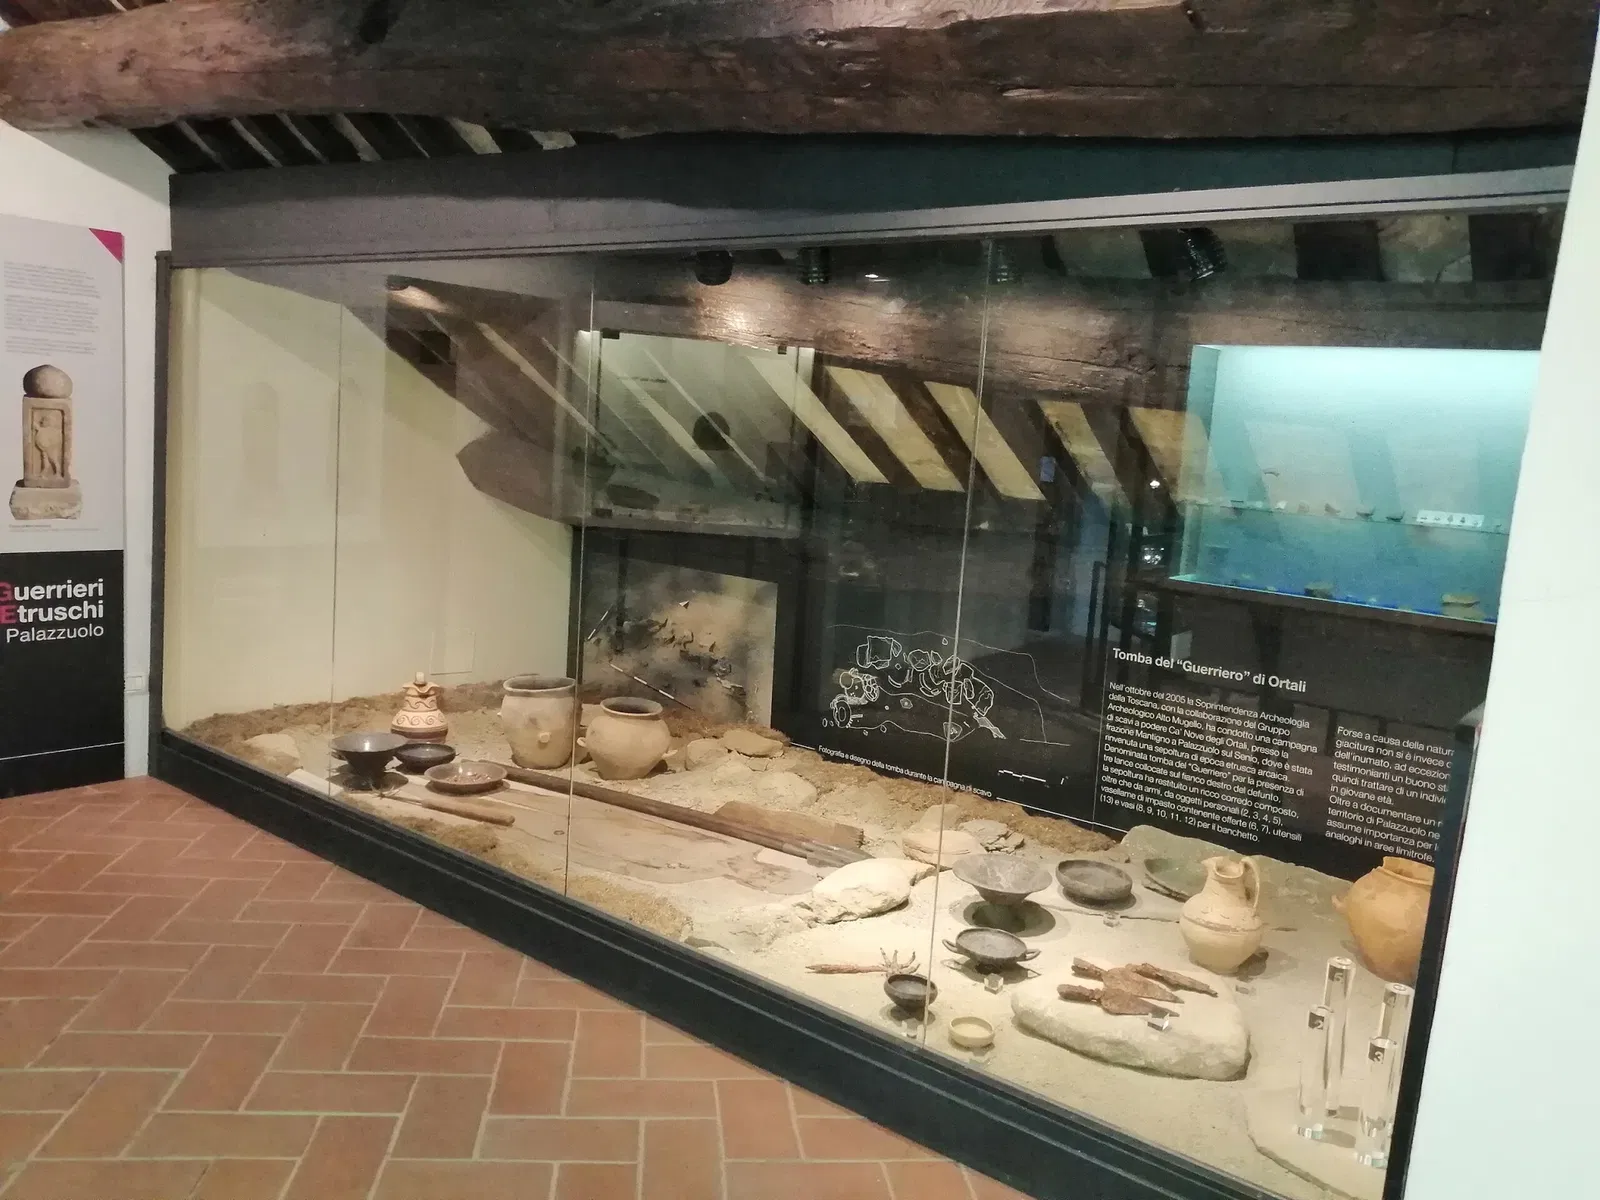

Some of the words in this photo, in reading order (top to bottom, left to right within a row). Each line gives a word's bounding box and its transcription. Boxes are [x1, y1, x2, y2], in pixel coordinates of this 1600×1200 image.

[0, 578, 104, 601] Guerrieri
[0, 600, 104, 624] Etruschi
[6, 623, 104, 643] Palazzuolo
[1112, 648, 1152, 664] Tomba
[1155, 655, 1174, 668] del
[1253, 673, 1266, 685] di
[1268, 676, 1307, 693] Ortali
[1109, 692, 1126, 702] della
[1161, 705, 1176, 713] con
[1177, 706, 1184, 714] la
[1185, 710, 1242, 726] collaborazione
[1243, 720, 1256, 729] del
[1258, 723, 1290, 737] Gruppo
[1153, 690, 1164, 699] del
[1166, 693, 1186, 704] 2005
[1187, 697, 1194, 705] la
[1195, 699, 1258, 718] Soprintendenza
[1260, 712, 1310, 729] Archeologia
[1107, 713, 1114, 721] di
[1115, 716, 1134, 725] scavi
[1141, 722, 1167, 733] podere
[1251, 746, 1280, 757] presso
[1281, 751, 1289, 759] la
[1108, 703, 1155, 719] Archeologico
[1156, 713, 1171, 722] Alto
[1206, 723, 1216, 732] ha
[1217, 727, 1253, 740] condotto
[1255, 735, 1271, 744] una
[1272, 739, 1318, 754] campagna
[1337, 726, 1363, 739] Forse
[1372, 735, 1401, 746] causa
[1402, 739, 1424, 751] della
[1105, 734, 1138, 747] rinvenuta
[1139, 743, 1153, 751] una
[1154, 746, 1190, 759] sepoltura
[1191, 753, 1198, 761] di
[1200, 757, 1224, 767] epoca
[1226, 762, 1256, 774] etrusca
[1106, 723, 1134, 736] frazione
[1135, 730, 1170, 744] Mantigno
[1178, 739, 1220, 755] Palazzuolo
[1261, 758, 1283, 769] dove
[1284, 763, 1290, 771] è
[1291, 765, 1313, 776] stata
[1336, 739, 1374, 753] giacitura
[1376, 748, 1394, 757] non
[1396, 751, 1404, 759] si
[1405, 752, 1412, 761] è
[1413, 754, 1444, 768] invece
[1103, 754, 1113, 763] tre
[1114, 757, 1134, 768] lance
[1135, 763, 1168, 776] collocate
[1169, 771, 1181, 779] sul
[1182, 773, 1205, 785] fianco
[1206, 778, 1232, 791] destro
[1233, 785, 1246, 794] del
[1104, 744, 1148, 760] Denominata
[1149, 754, 1173, 766] tomba
[1175, 760, 1187, 769] del
[1232, 775, 1246, 783] per
[1247, 777, 1255, 785] la
[1256, 781, 1295, 795] presenza
[1296, 788, 1305, 797] di
[1333, 762, 1390, 781] testimonianti
[1391, 776, 1403, 784] un
[1405, 777, 1436, 791] buono
[1394, 764, 1407, 772] ad
[1102, 775, 1117, 785] oltre
[1119, 780, 1132, 788] che
[1133, 782, 1143, 791] da
[1164, 790, 1174, 799] da
[1175, 794, 1203, 806] oggetti
[1203, 801, 1240, 815] personali
[1103, 764, 1109, 772] la
[1110, 768, 1144, 781] sepoltura
[1145, 774, 1154, 783] ha
[1156, 779, 1188, 791] restituito
[1200, 789, 1220, 799] ricco
[1221, 795, 1253, 807] corredo
[1330, 785, 1339, 793] in
[1340, 788, 1375, 802] giovane
[1331, 775, 1359, 786] quindi
[1361, 780, 1394, 794] trattare
[1395, 787, 1405, 796] di
[1406, 791, 1418, 799] un
[1101, 786, 1136, 800] vasellame
[1137, 794, 1144, 802] di
[1145, 796, 1176, 810] impasto
[1176, 805, 1220, 821] contenente
[1221, 816, 1247, 828] offerte
[1272, 829, 1302, 842] utensili
[1121, 802, 1135, 810] vasi
[1197, 821, 1211, 829] per
[1328, 807, 1364, 822] territorio
[1366, 816, 1375, 825] di
[1376, 818, 1426, 837] Palazzuolo
[1329, 796, 1351, 808] Oltre
[1360, 803, 1422, 824] documentare
[1423, 819, 1436, 827] un
[1325, 831, 1363, 845] analoghi
[1364, 839, 1372, 847] in
[1374, 843, 1394, 853] aree
[1326, 820, 1362, 833] assume
[1363, 827, 1415, 846] importanza
[1416, 841, 1433, 850] per
